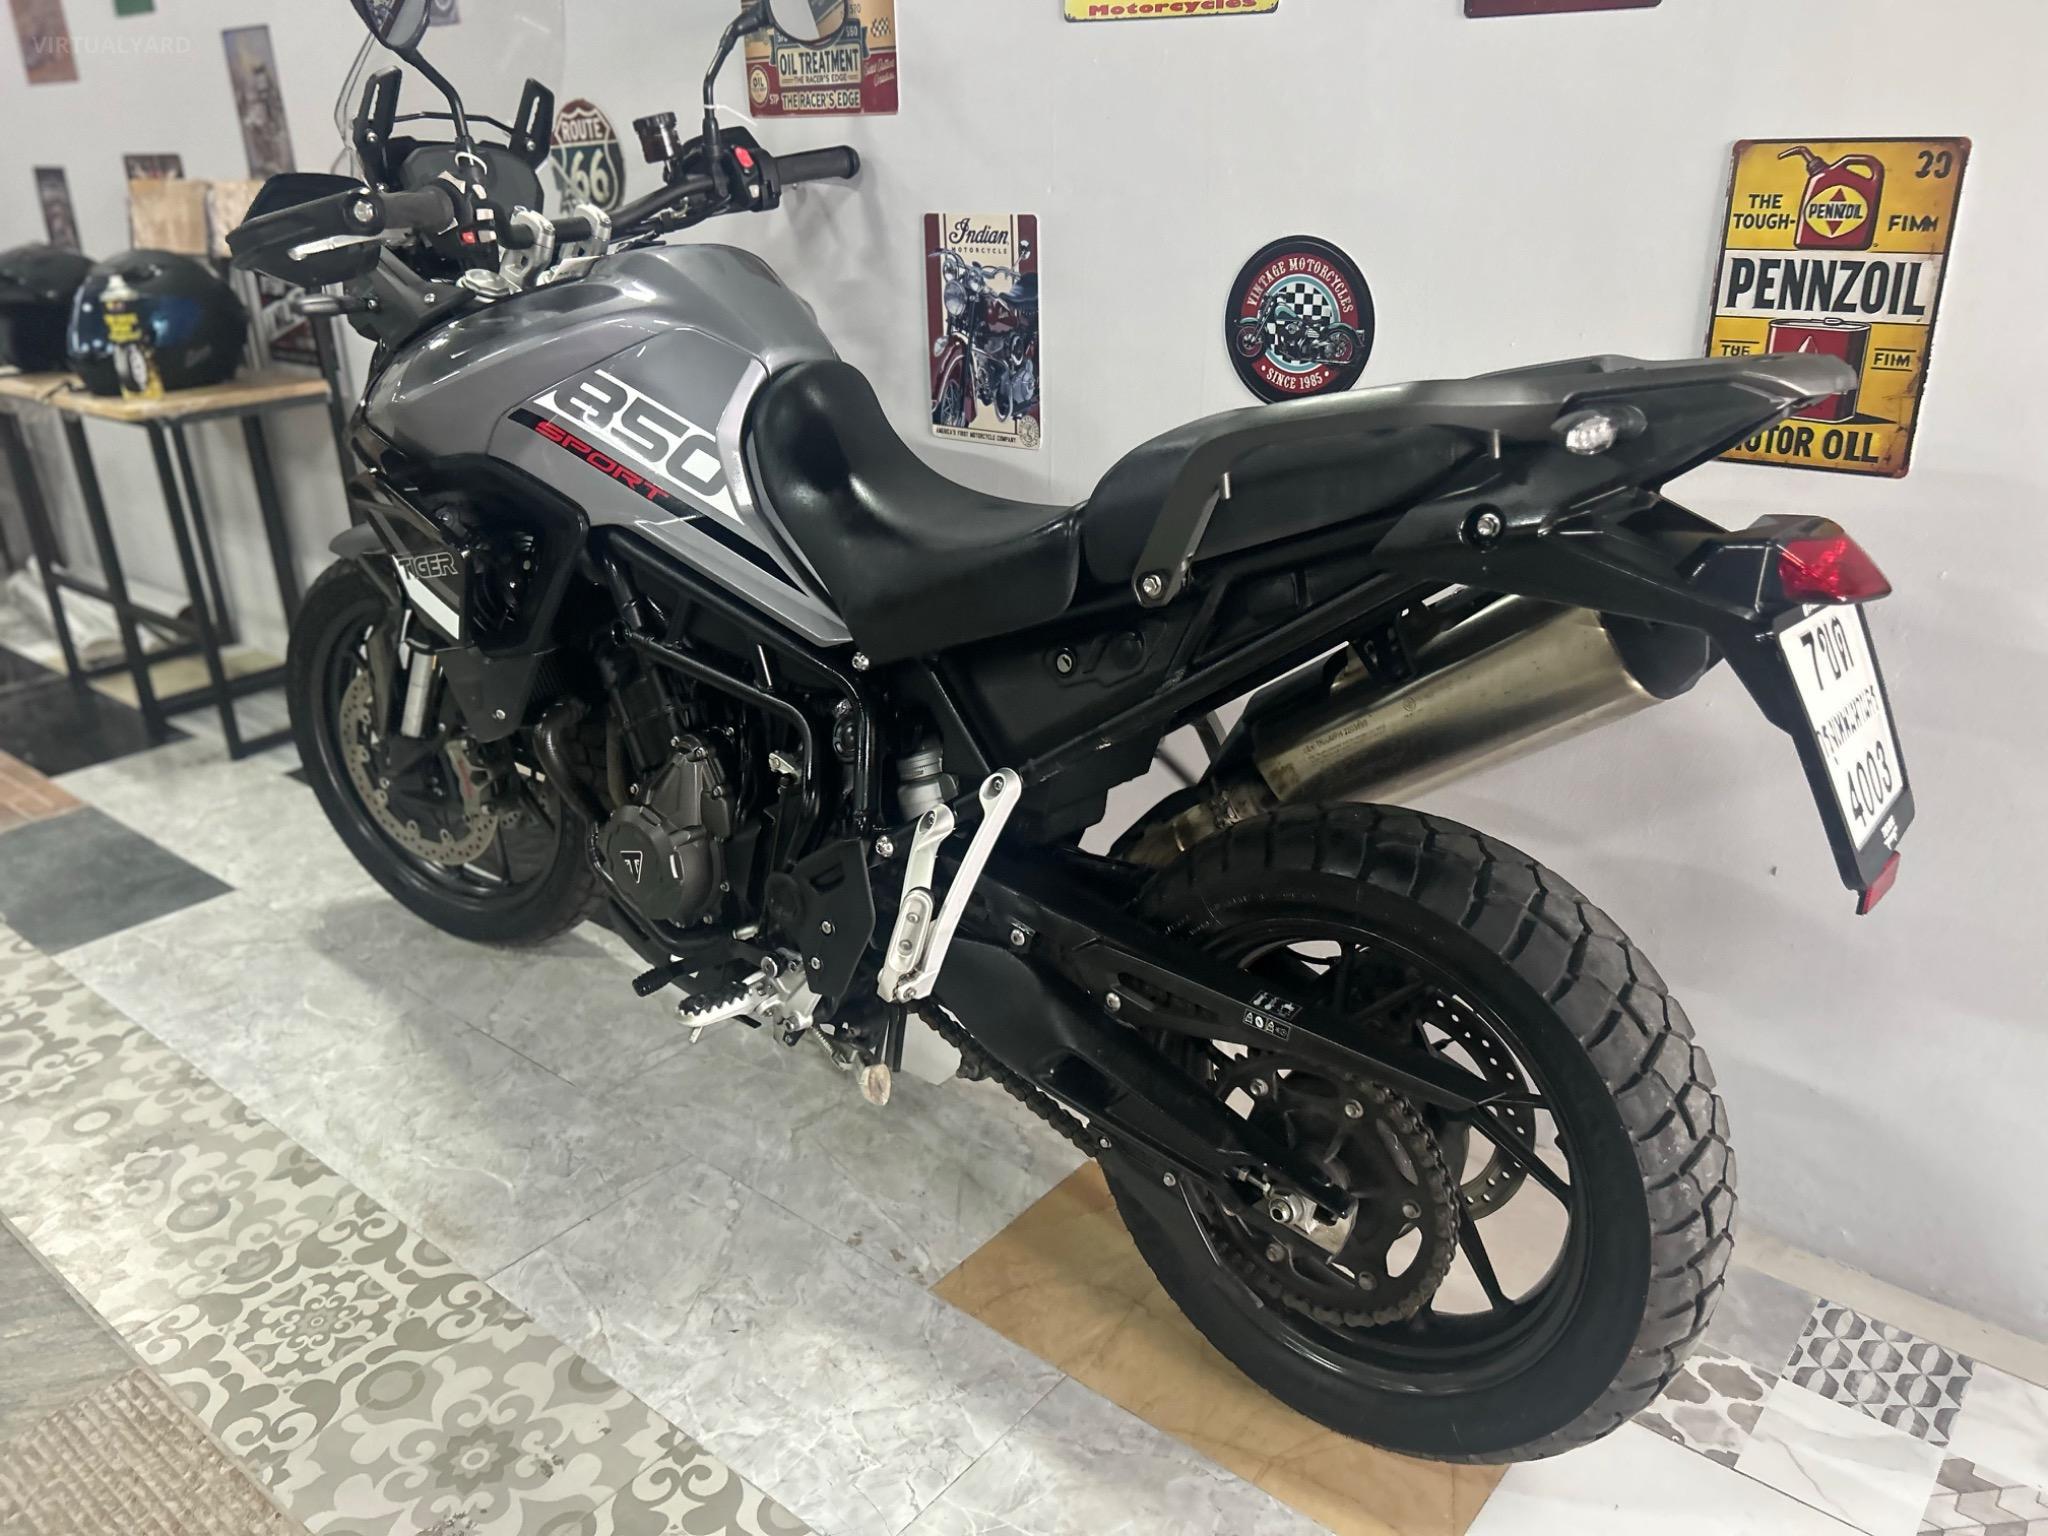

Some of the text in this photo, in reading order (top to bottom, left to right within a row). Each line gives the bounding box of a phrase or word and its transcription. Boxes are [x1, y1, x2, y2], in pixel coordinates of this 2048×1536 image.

[1089, 0, 1257, 16] Motorcycles
[780, 53, 797, 75] OIL
[800, 50, 859, 75] TREATMENT
[794, 74, 847, 84] THE RACER'S EDGE
[783, 91, 860, 109] THE RACER'S EDGE
[561, 119, 603, 141] ROUTE
[571, 148, 609, 203] 66
[1748, 194, 1783, 209] THE
[1808, 203, 1863, 220] PENNZOIL
[949, 217, 1009, 244] Indian
[1733, 213, 1796, 230] TOUGH-
[952, 246, 1007, 255] MOTORCYCLE
[1247, 257, 1354, 313] VINTAGE MOTORCYCLES
[1725, 257, 1925, 316] PENNZOIL
[1266, 368, 1323, 389] SINCE 1985
[554, 372, 728, 497] 850
[1735, 425, 1815, 458] OTOR
[535, 420, 670, 501] SPORT
[398, 552, 459, 580] TIGER
[1847, 741, 1892, 827] 4003
